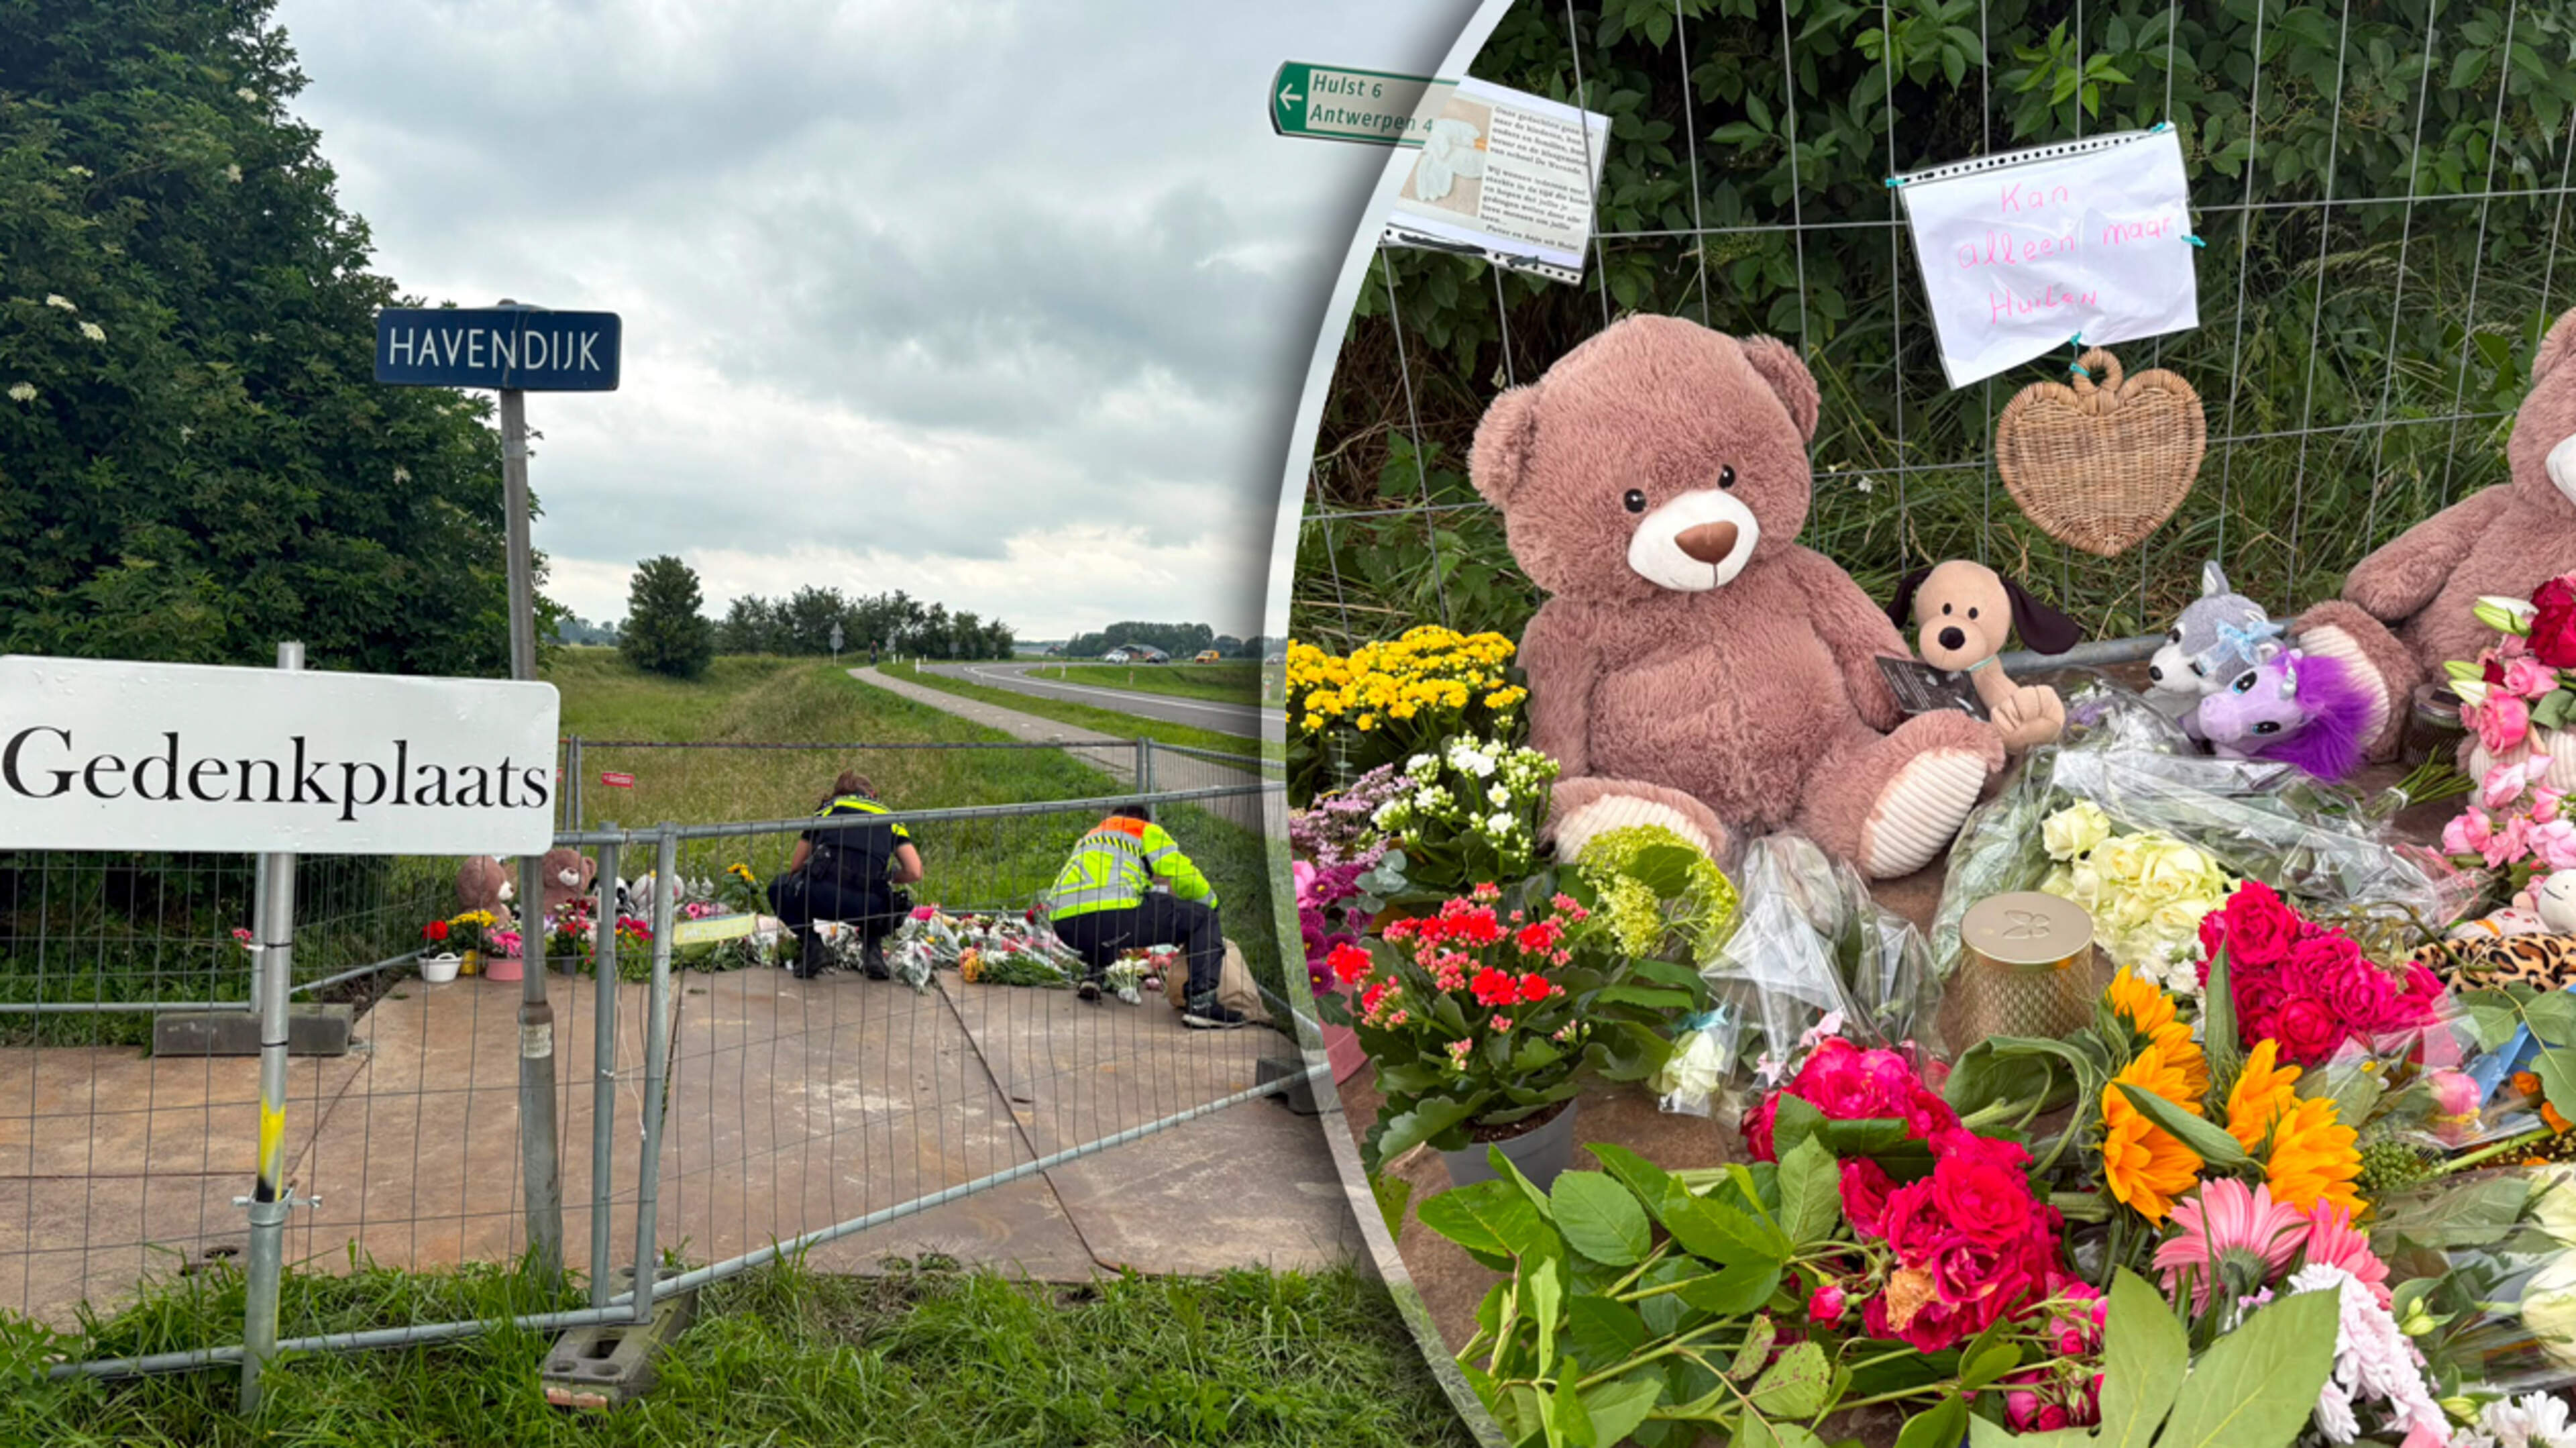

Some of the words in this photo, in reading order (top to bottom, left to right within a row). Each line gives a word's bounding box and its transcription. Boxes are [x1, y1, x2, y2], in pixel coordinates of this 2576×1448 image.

[1313, 74, 1366, 97] Hulst
[1372, 83, 1383, 99] 6
[1310, 104, 1415, 133] Antwerpen
[2000, 183, 2068, 213] Kan
[1958, 230, 2075, 269] alleen
[2102, 216, 2170, 246] maar
[389, 327, 600, 371] HAVENDIJK
[2, 726, 548, 821] Gedenkplaats
